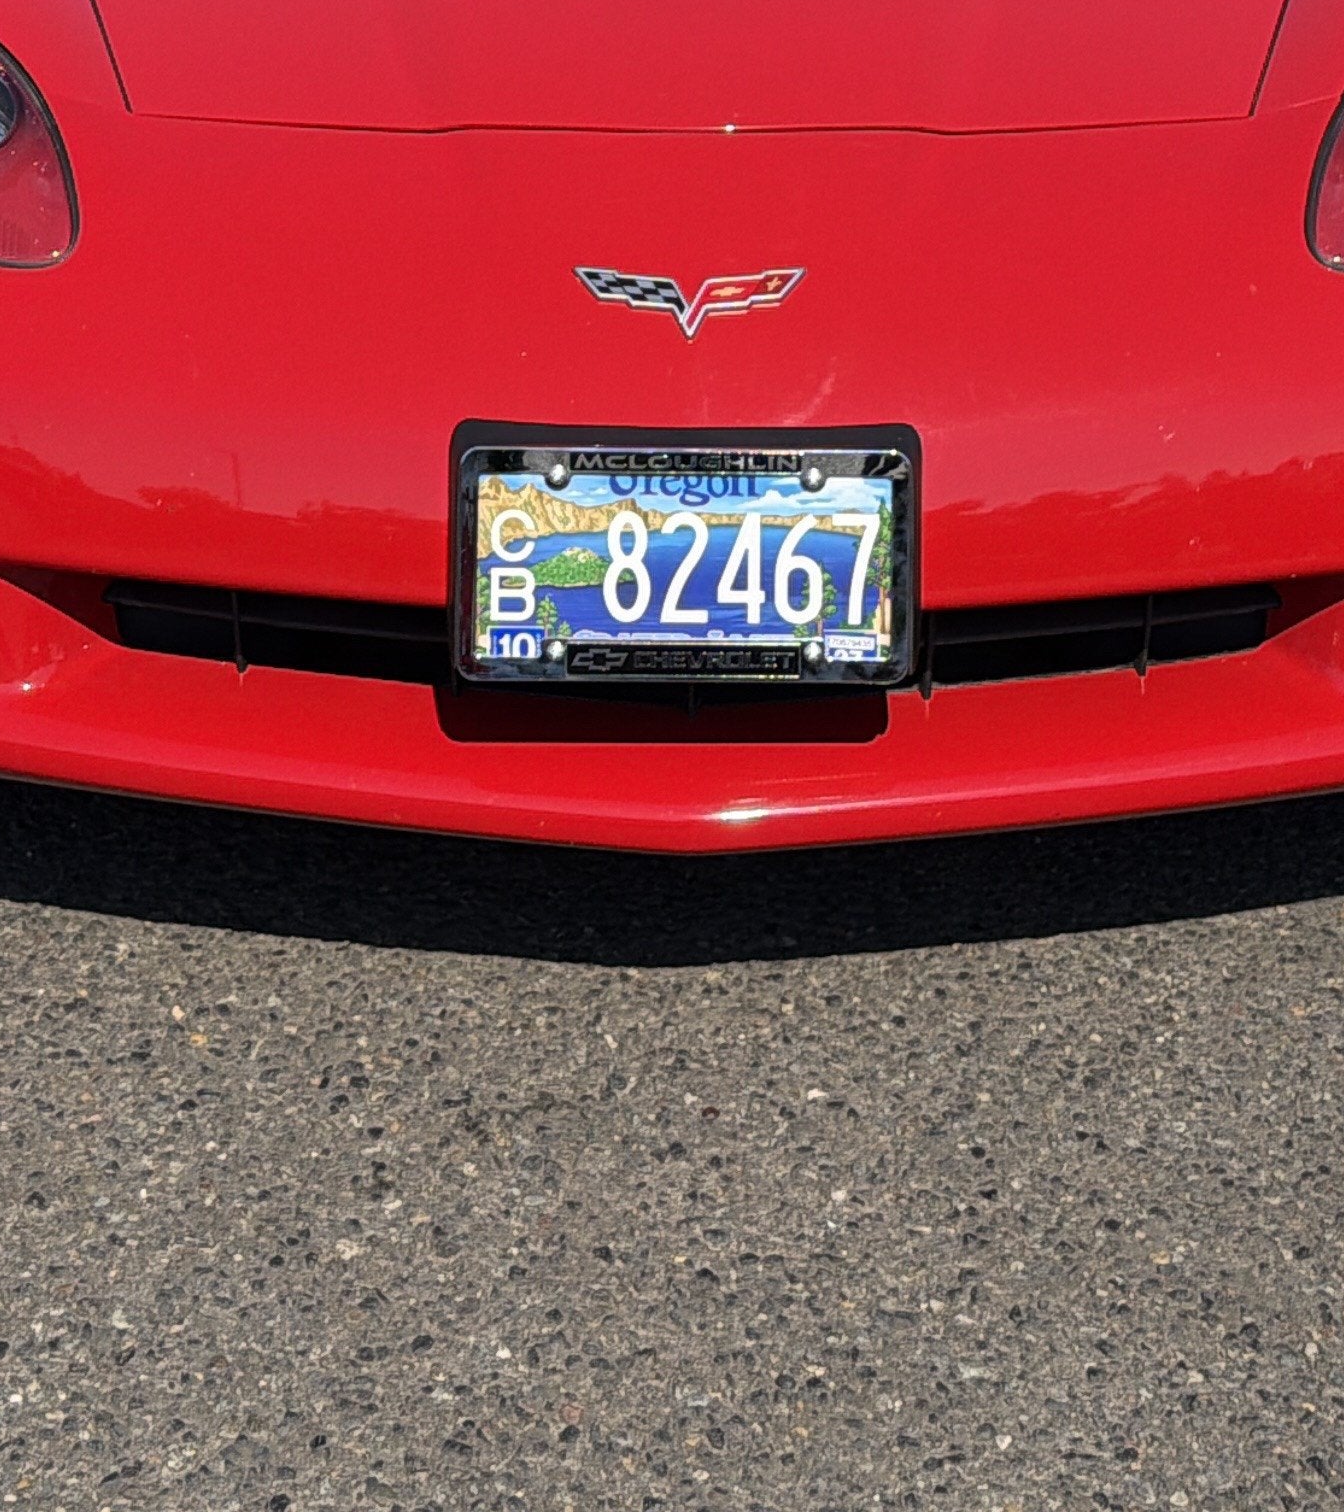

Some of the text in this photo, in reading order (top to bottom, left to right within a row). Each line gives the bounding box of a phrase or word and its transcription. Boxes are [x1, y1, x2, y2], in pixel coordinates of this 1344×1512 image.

[573, 453, 798, 471] MCLOUGHLIN
[608, 474, 764, 507] Oregon
[602, 510, 882, 625] 82467
[632, 649, 796, 670] CHEVROLET
